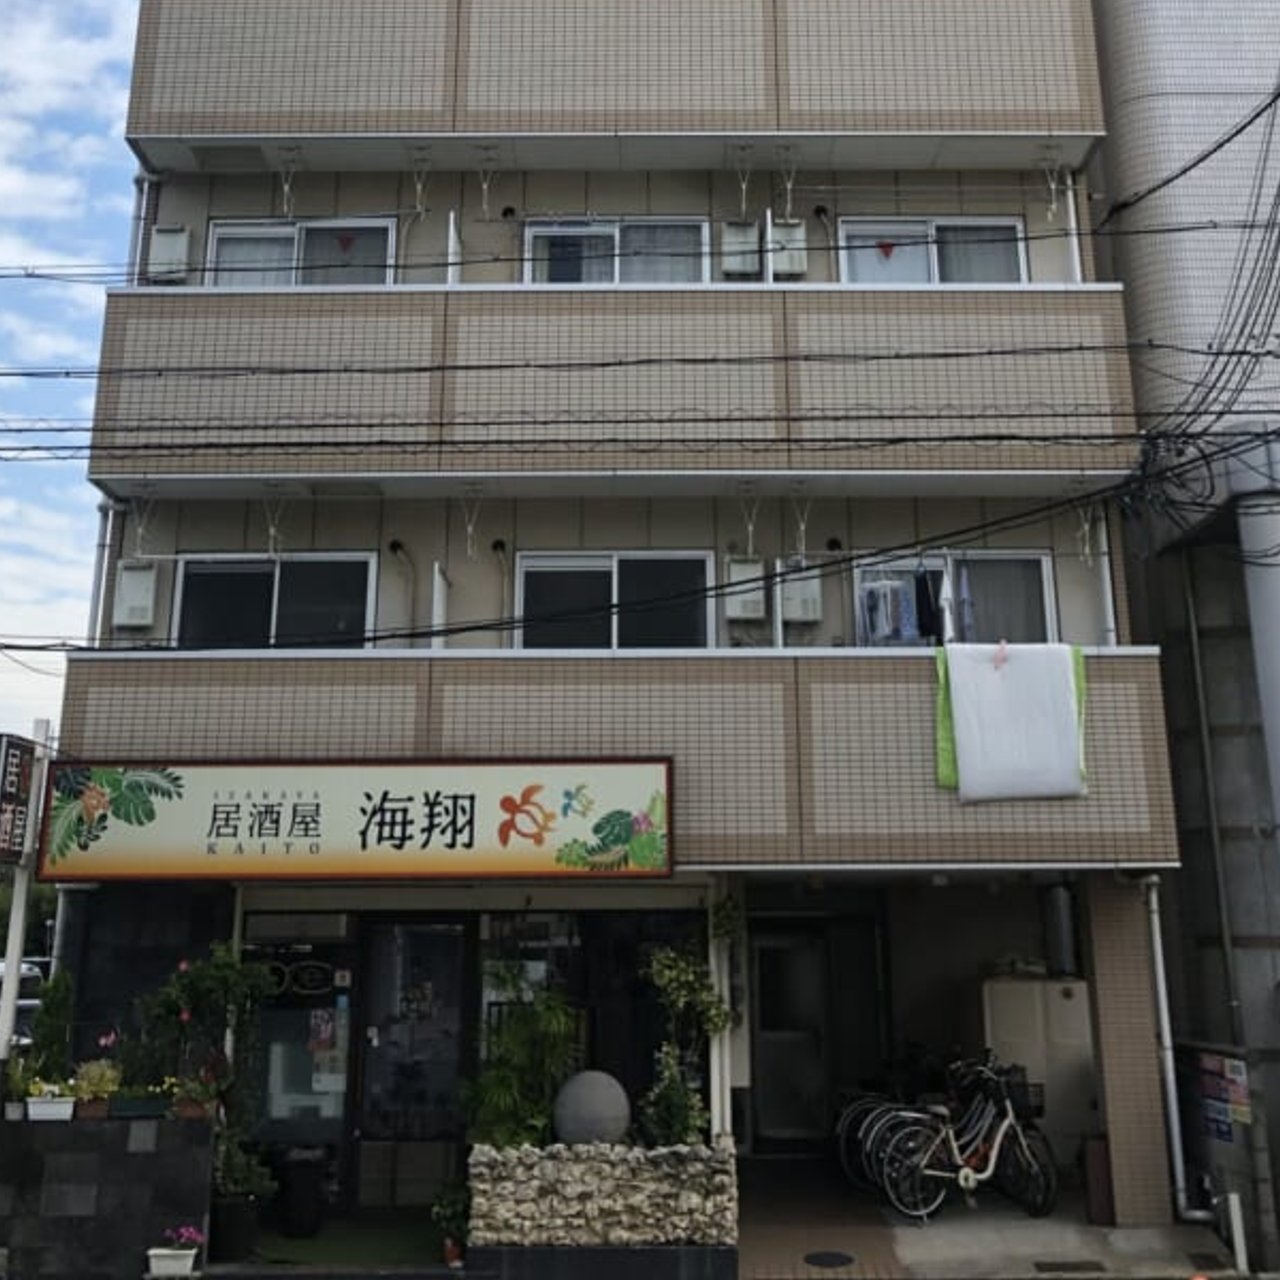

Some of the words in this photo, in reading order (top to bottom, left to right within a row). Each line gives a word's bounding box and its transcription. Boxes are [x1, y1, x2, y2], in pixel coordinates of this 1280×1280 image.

[206, 802, 321, 838] 居酒屋
[359, 790, 476, 851] 海翔
[206, 842, 320, 855] KAITO
